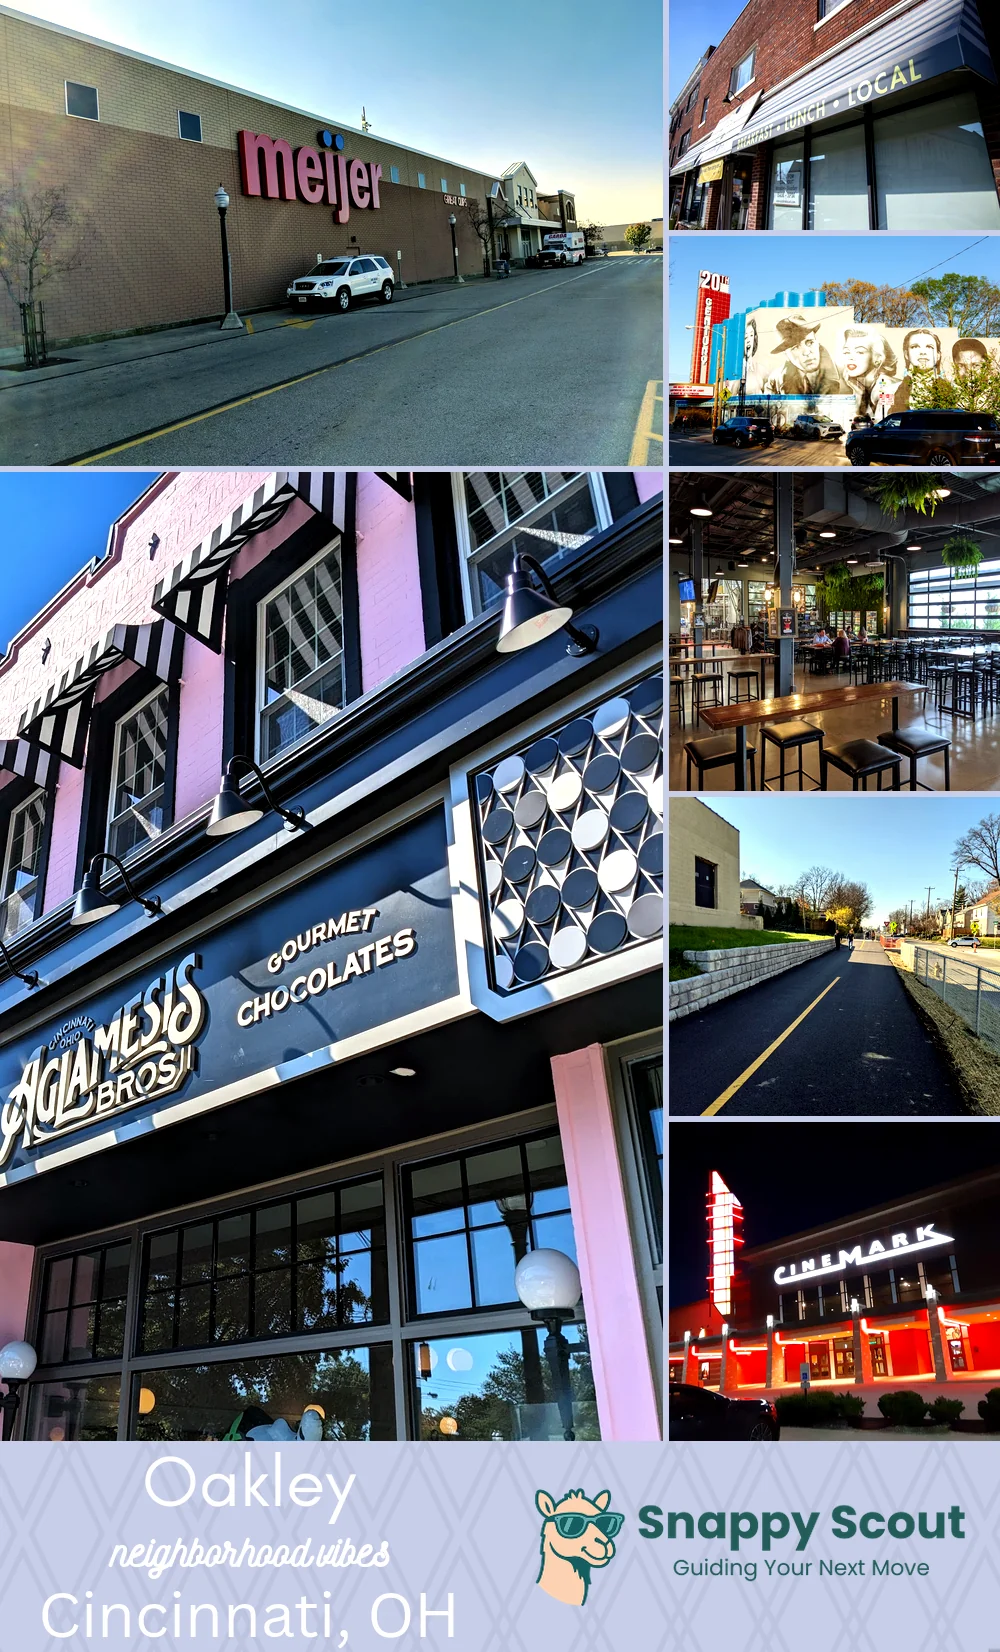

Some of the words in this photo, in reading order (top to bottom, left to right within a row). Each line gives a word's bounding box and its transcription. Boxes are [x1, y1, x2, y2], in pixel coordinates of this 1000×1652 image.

[736, 124, 773, 150] BREAKFAST
[784, 100, 826, 132] LUNCH
[848, 58, 922, 107] LOCAL
[238, 129, 382, 225] meijer
[237, 928, 417, 1028] CHOCOLATES
[267, 908, 379, 974] GOURMET
[0, 952, 206, 1168] AGLAMESIS
[48, 1015, 95, 1051] CINCINNATI
[59, 1030, 82, 1050] OHIO
[773, 1223, 956, 1285] CINEMARK
